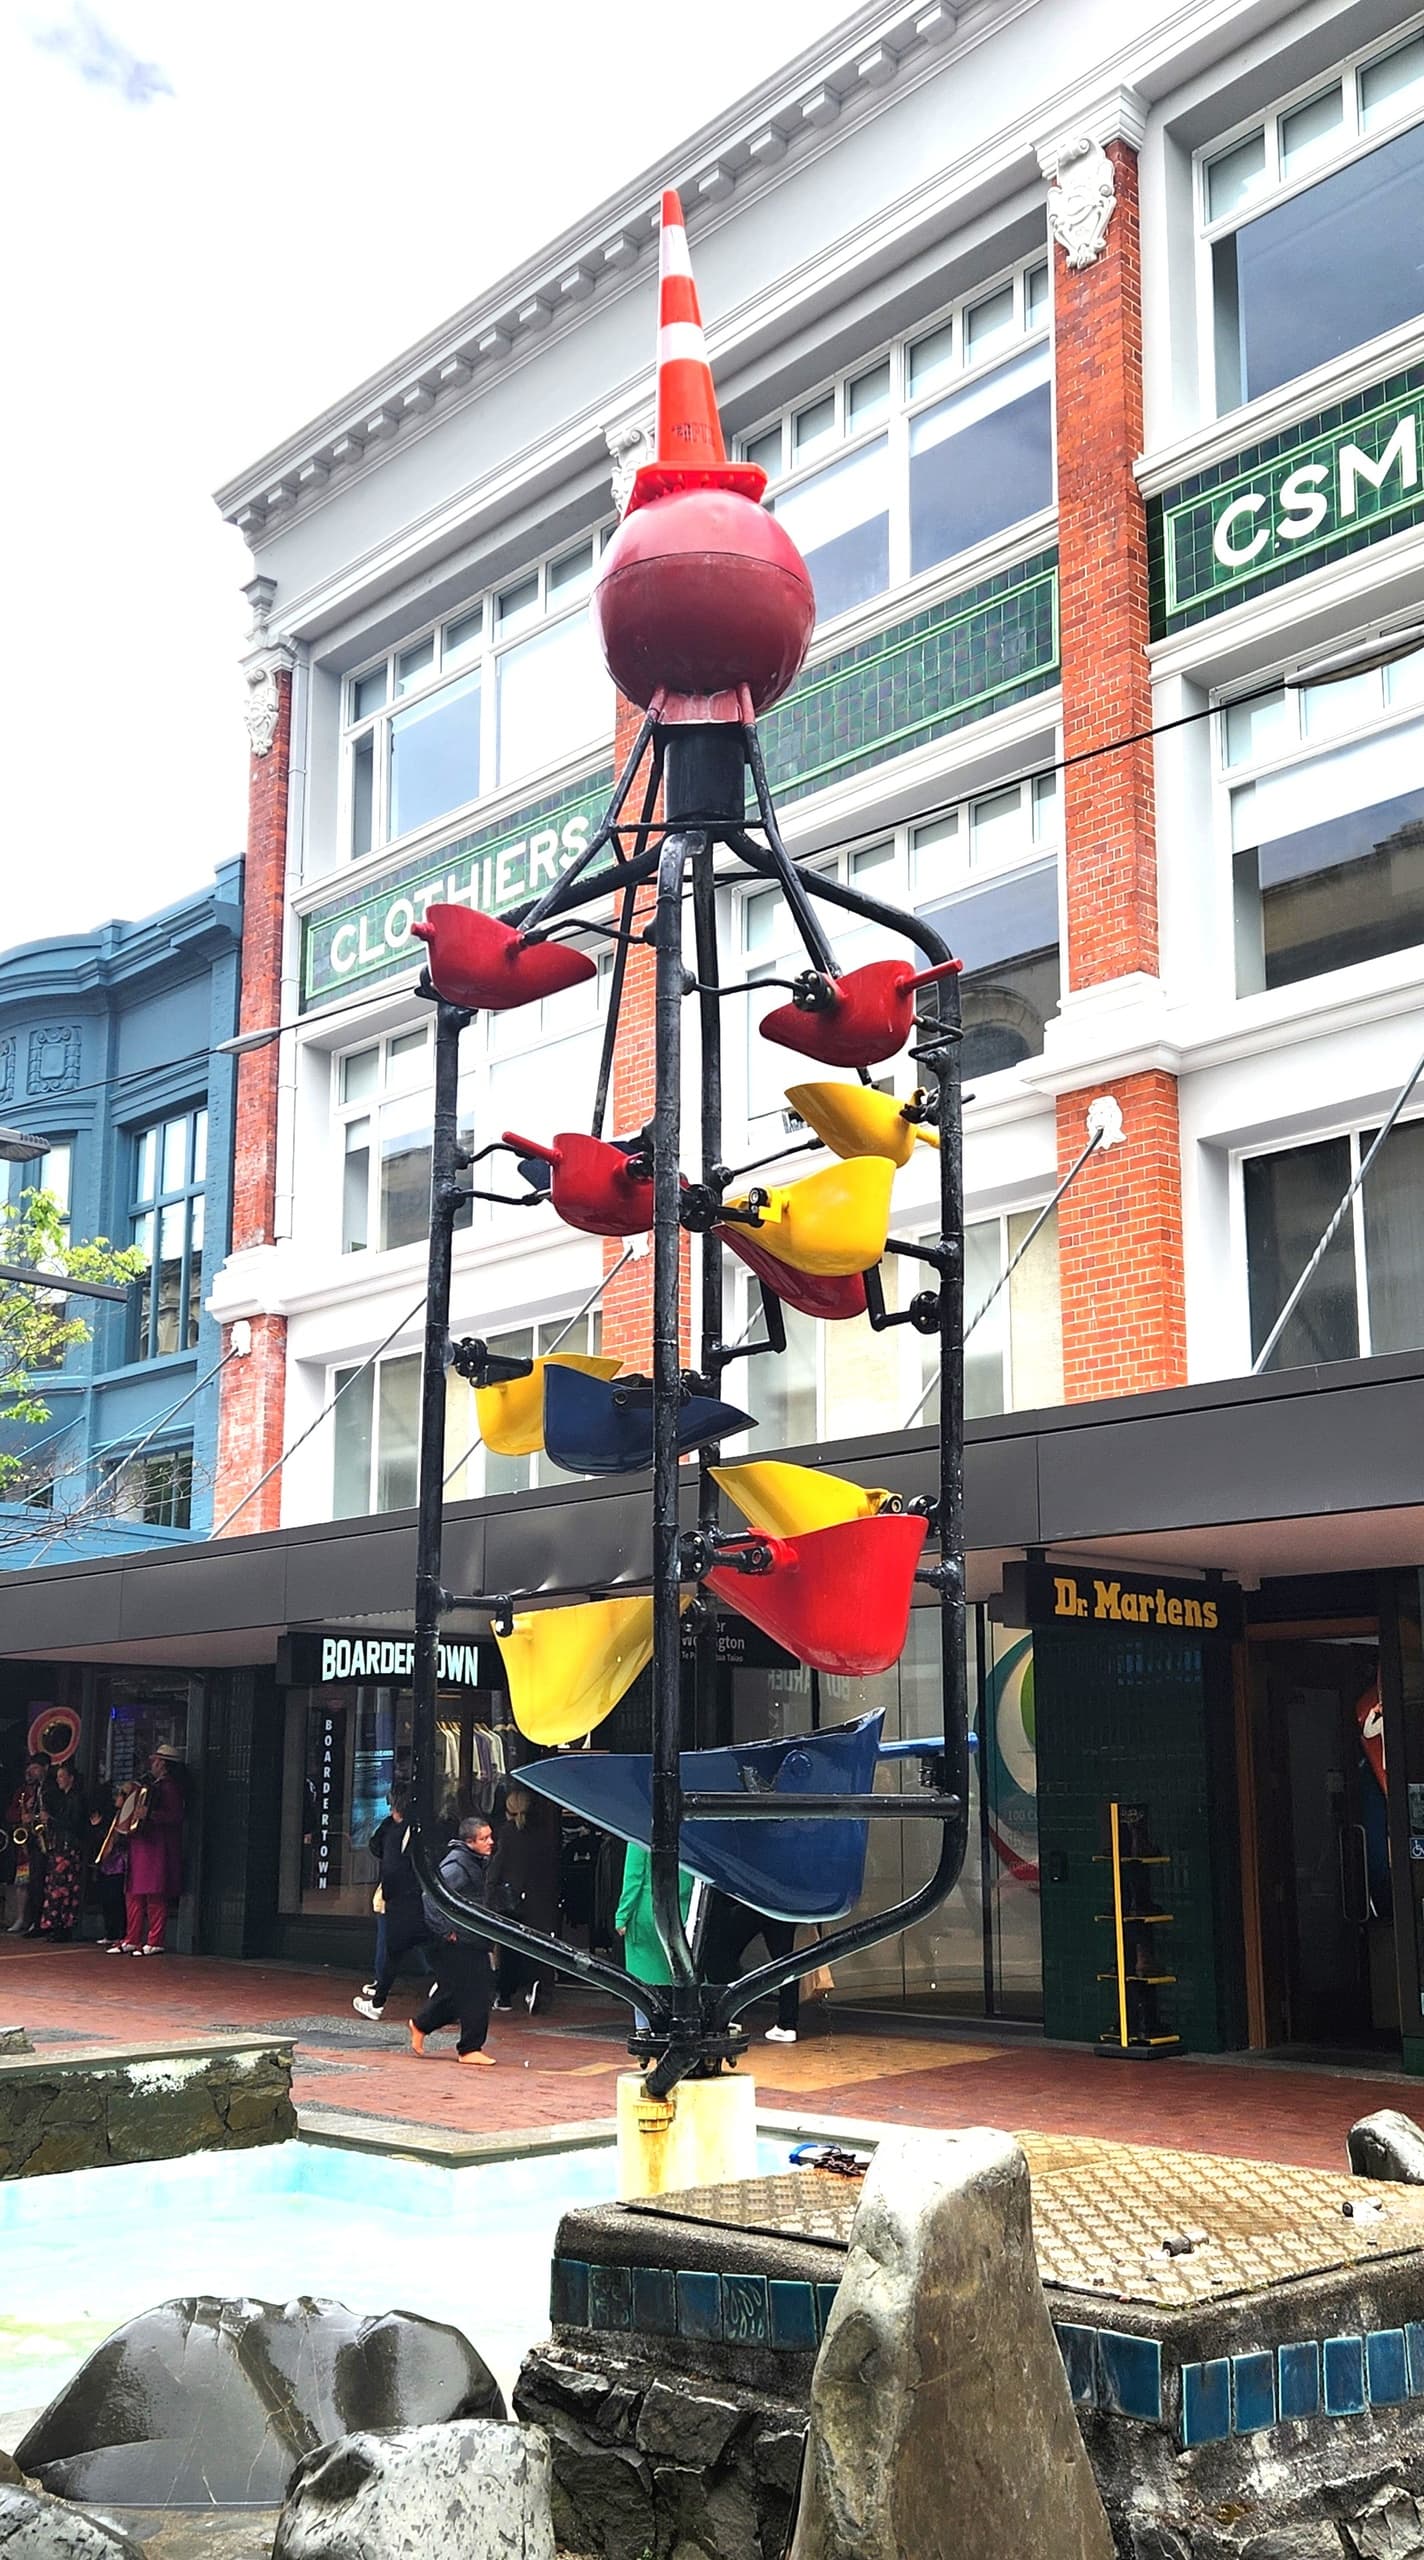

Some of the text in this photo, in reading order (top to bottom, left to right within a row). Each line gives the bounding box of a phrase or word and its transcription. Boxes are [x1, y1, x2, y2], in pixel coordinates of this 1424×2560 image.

[1092, 1580, 1219, 1629] Martens
[322, 1638, 479, 1688] BOARDEROWN
[318, 1719, 333, 1889] BOARDERTOWN
